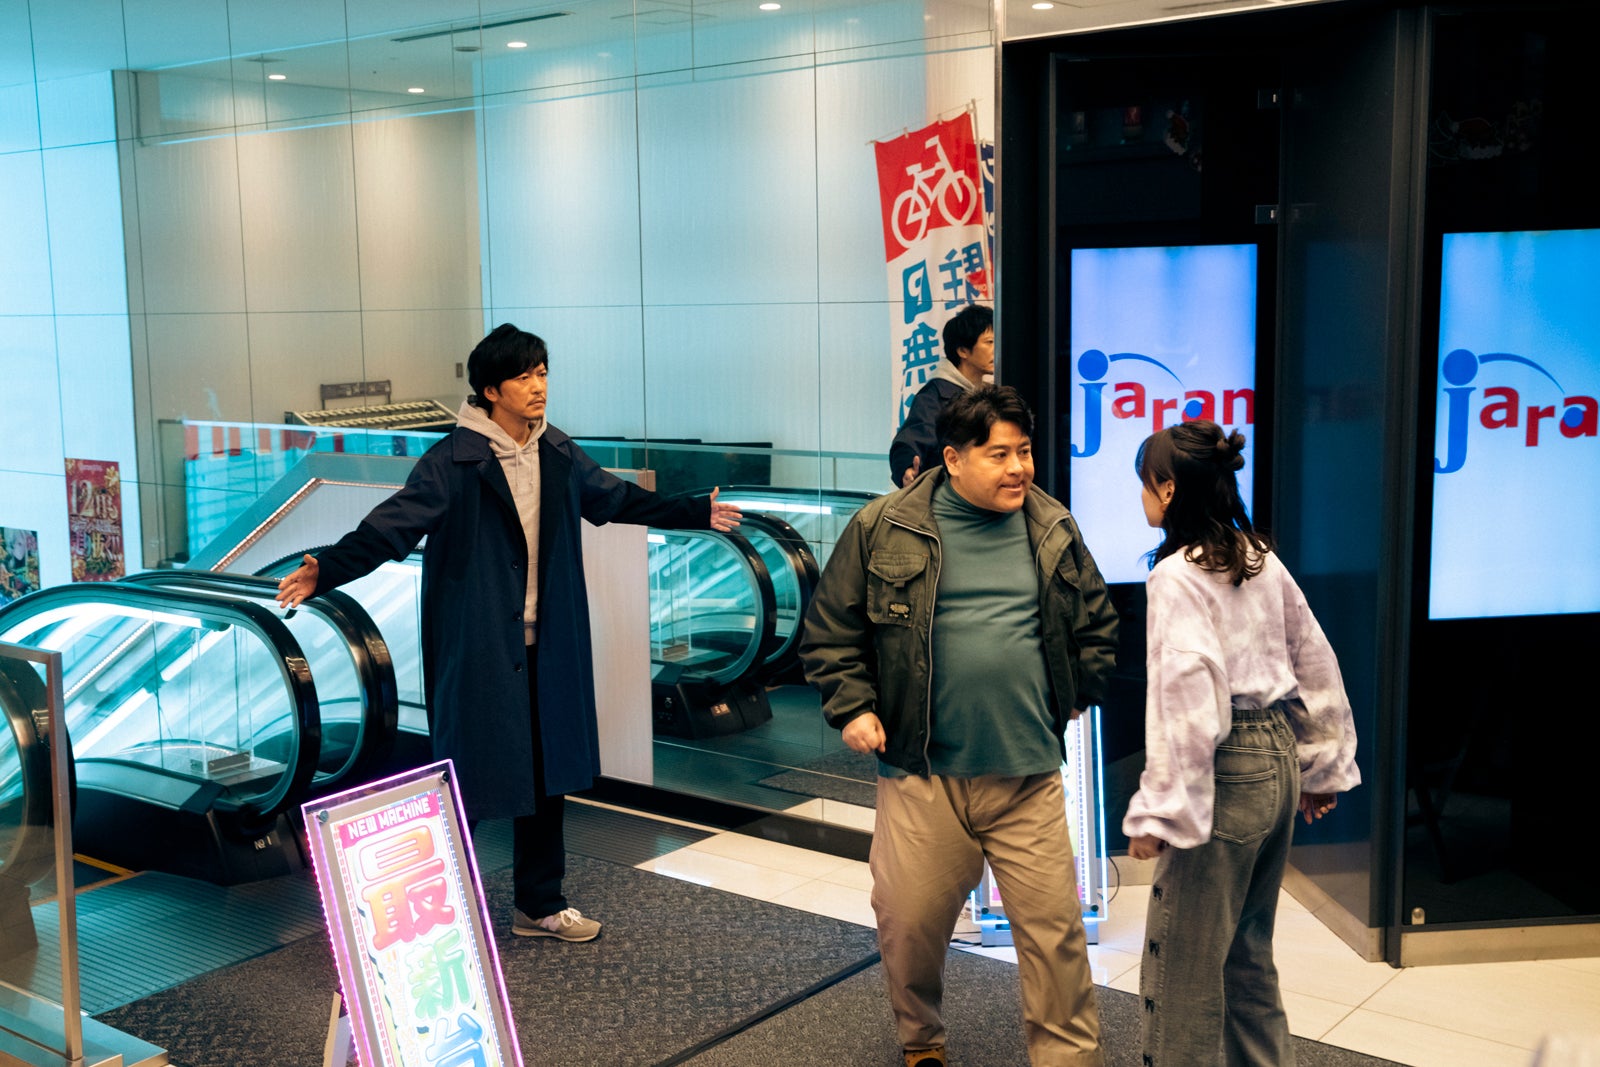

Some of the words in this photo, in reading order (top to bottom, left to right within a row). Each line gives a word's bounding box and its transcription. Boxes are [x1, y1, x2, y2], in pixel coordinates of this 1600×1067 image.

[1071, 349, 1255, 458] jaran
[347, 816, 379, 840] NEW
[378, 797, 431, 828] MACHINE
